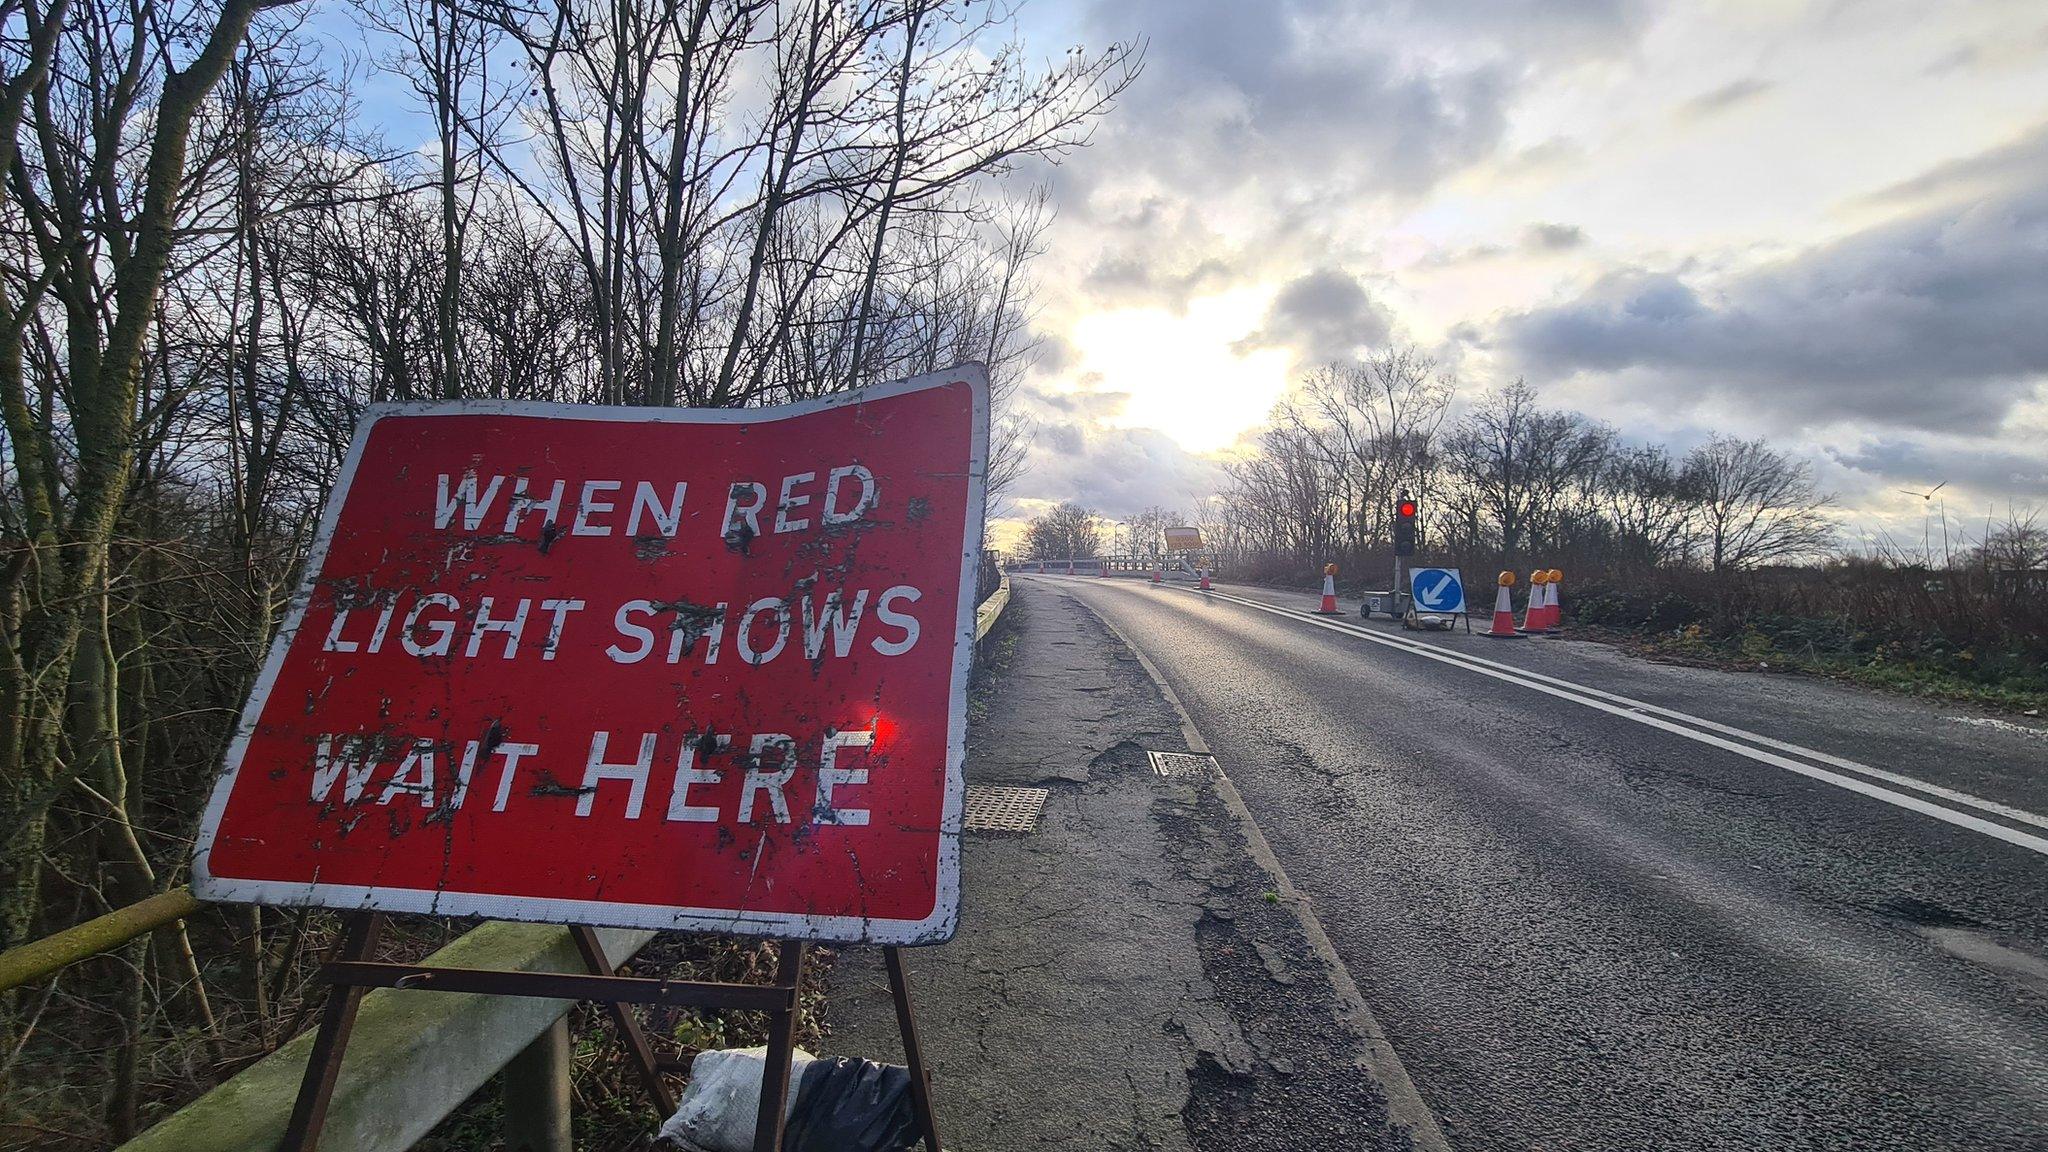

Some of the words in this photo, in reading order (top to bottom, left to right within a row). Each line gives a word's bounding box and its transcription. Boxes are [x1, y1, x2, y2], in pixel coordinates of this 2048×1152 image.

[433, 473, 688, 537] WHEN
[720, 464, 877, 538] RED
[322, 592, 585, 661] LIGHT
[605, 585, 922, 665] SHOWS
[309, 732, 540, 812] WAIT
[574, 731, 873, 826] HERE
